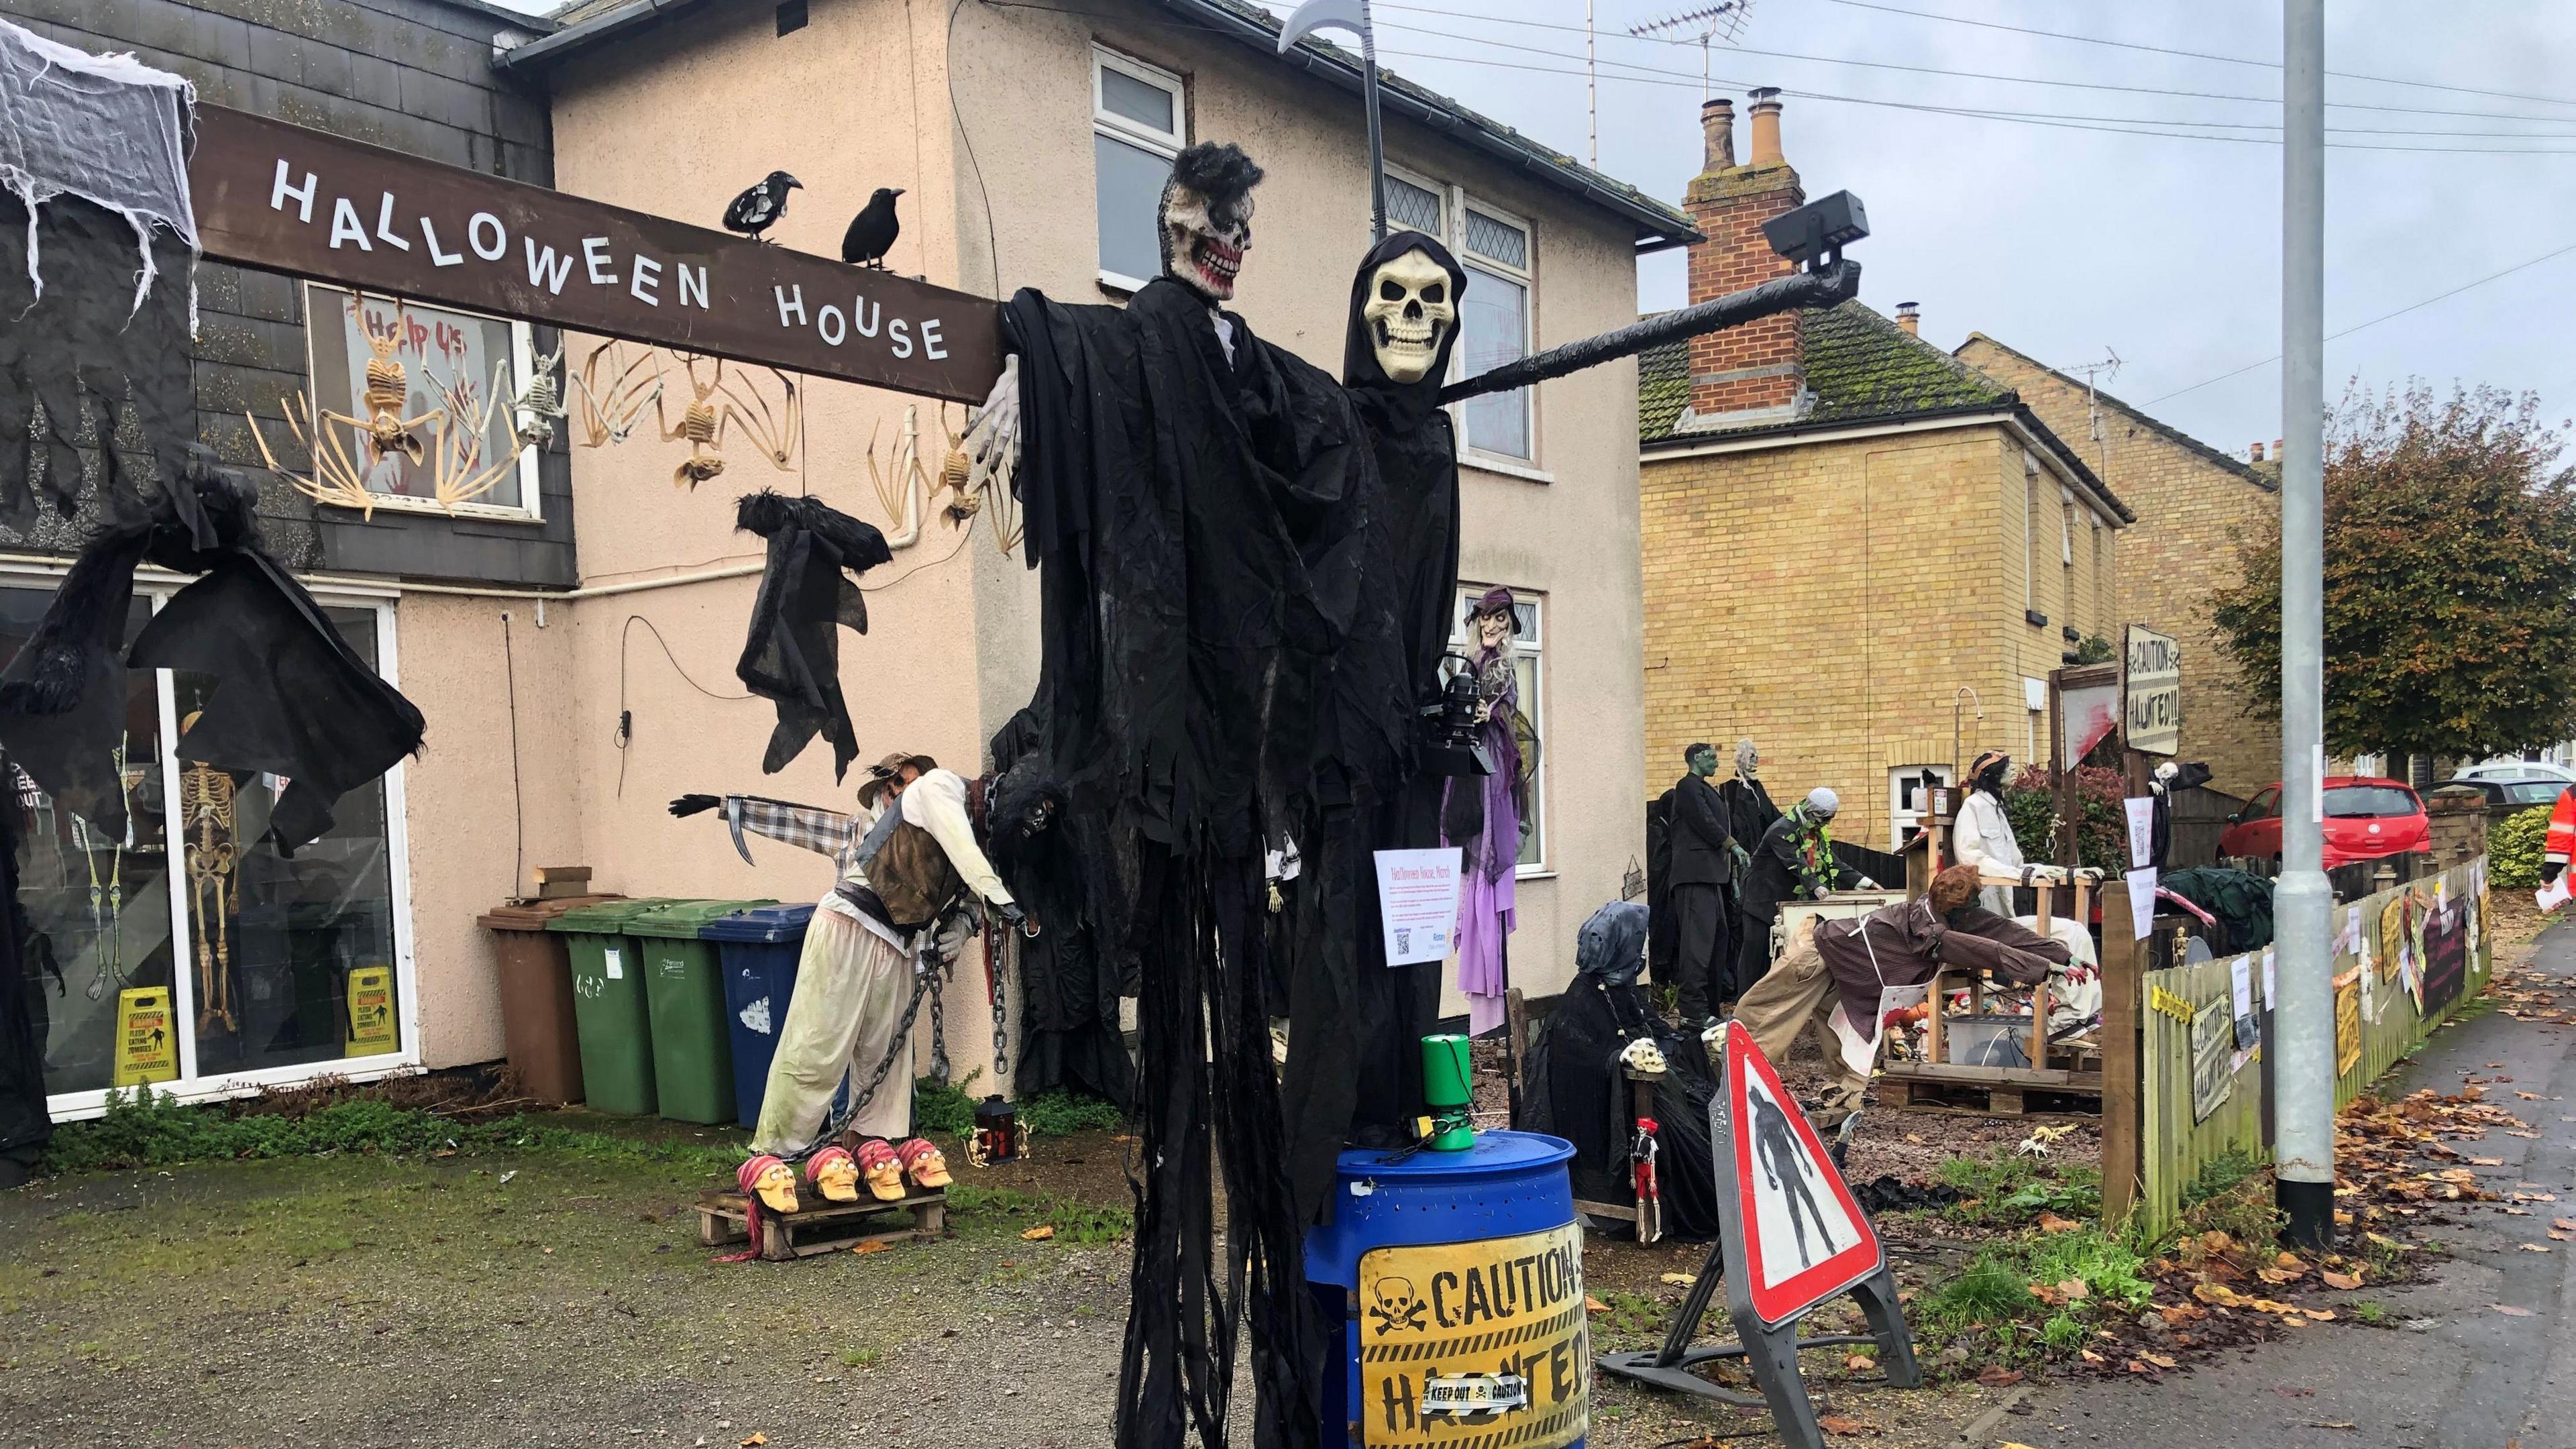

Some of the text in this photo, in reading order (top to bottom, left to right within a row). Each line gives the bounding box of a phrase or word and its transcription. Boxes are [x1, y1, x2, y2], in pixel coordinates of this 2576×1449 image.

[270, 158, 948, 361] HALLOWEEN HOUSE
[365, 309, 431, 360] Help
[2137, 640, 2169, 674] CAUTION
[2129, 689, 2178, 731] HAUNTED!!
[1432, 1240, 1576, 1330] CAUTION
[1431, 1386, 1453, 1401] KEEP
[1454, 1386, 1471, 1401] OUT
[1492, 1381, 1521, 1400] CAUTION
